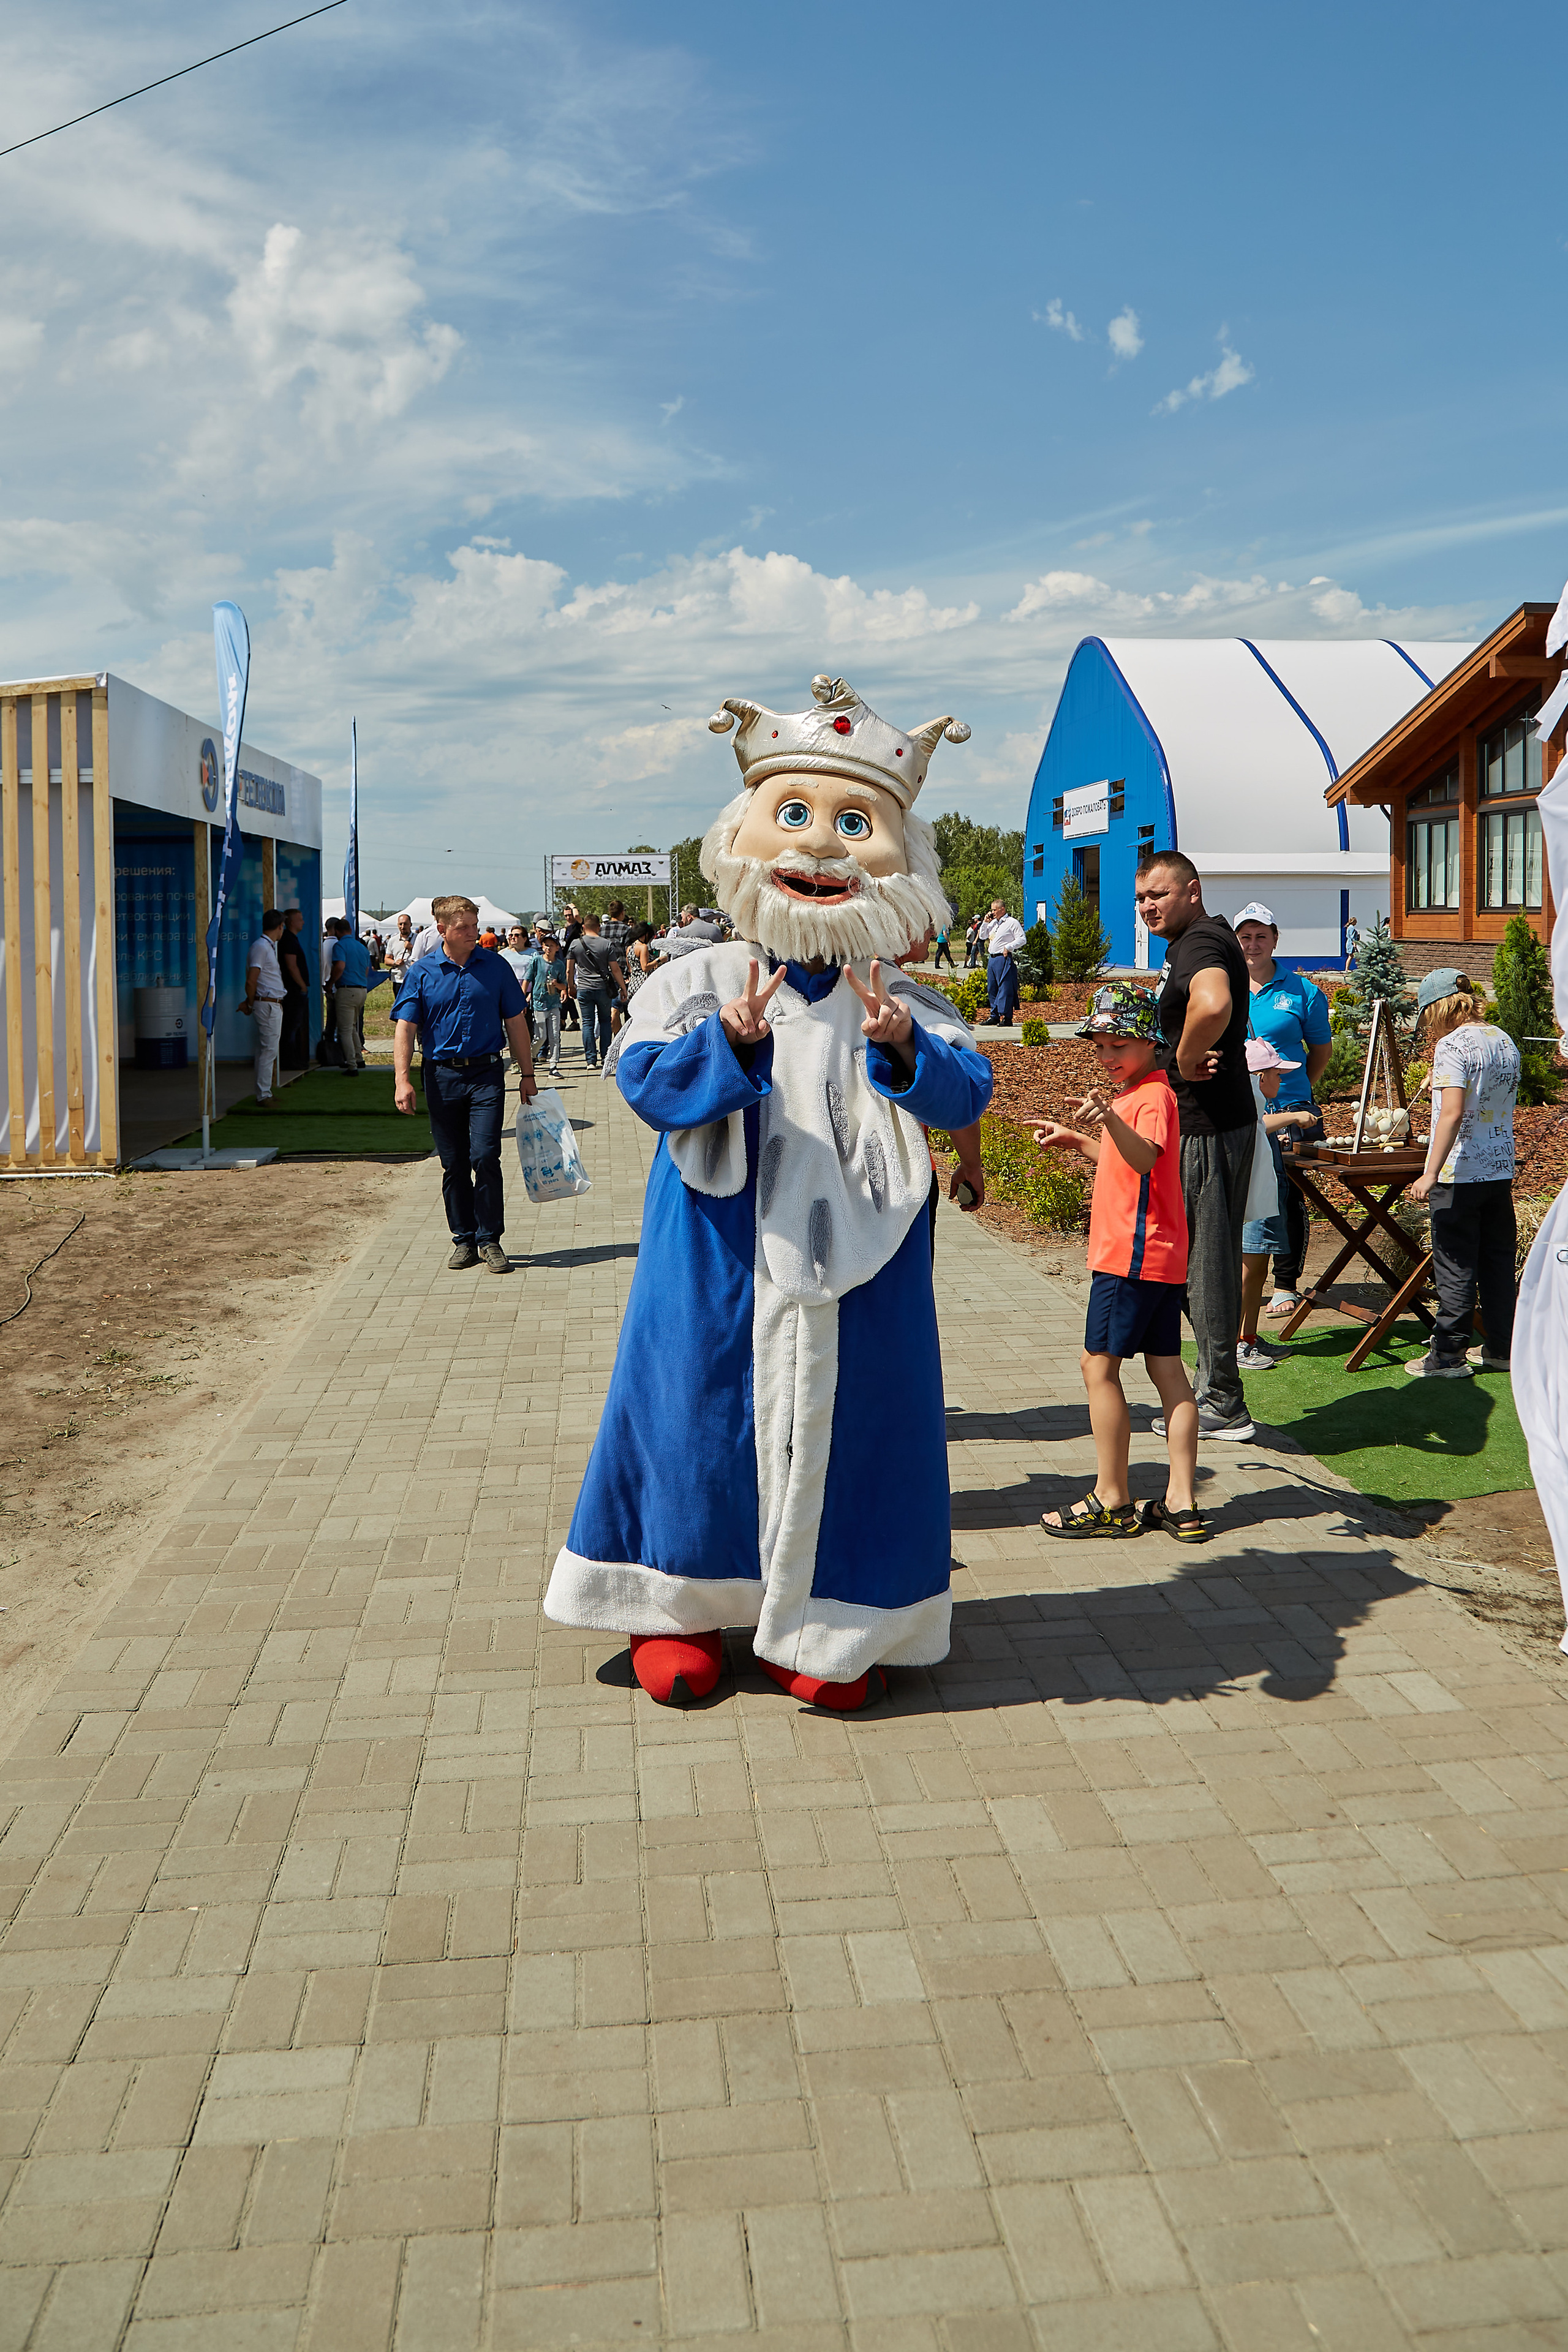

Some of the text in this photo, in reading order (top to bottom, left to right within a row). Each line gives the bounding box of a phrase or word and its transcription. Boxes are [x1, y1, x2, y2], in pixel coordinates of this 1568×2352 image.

[115, 867, 176, 878] решения:
[595, 861, 652, 876] АЛМАЗ
[132, 932, 196, 944] температу
[218, 932, 249, 943] ерна
[138, 950, 162, 961] КРС
